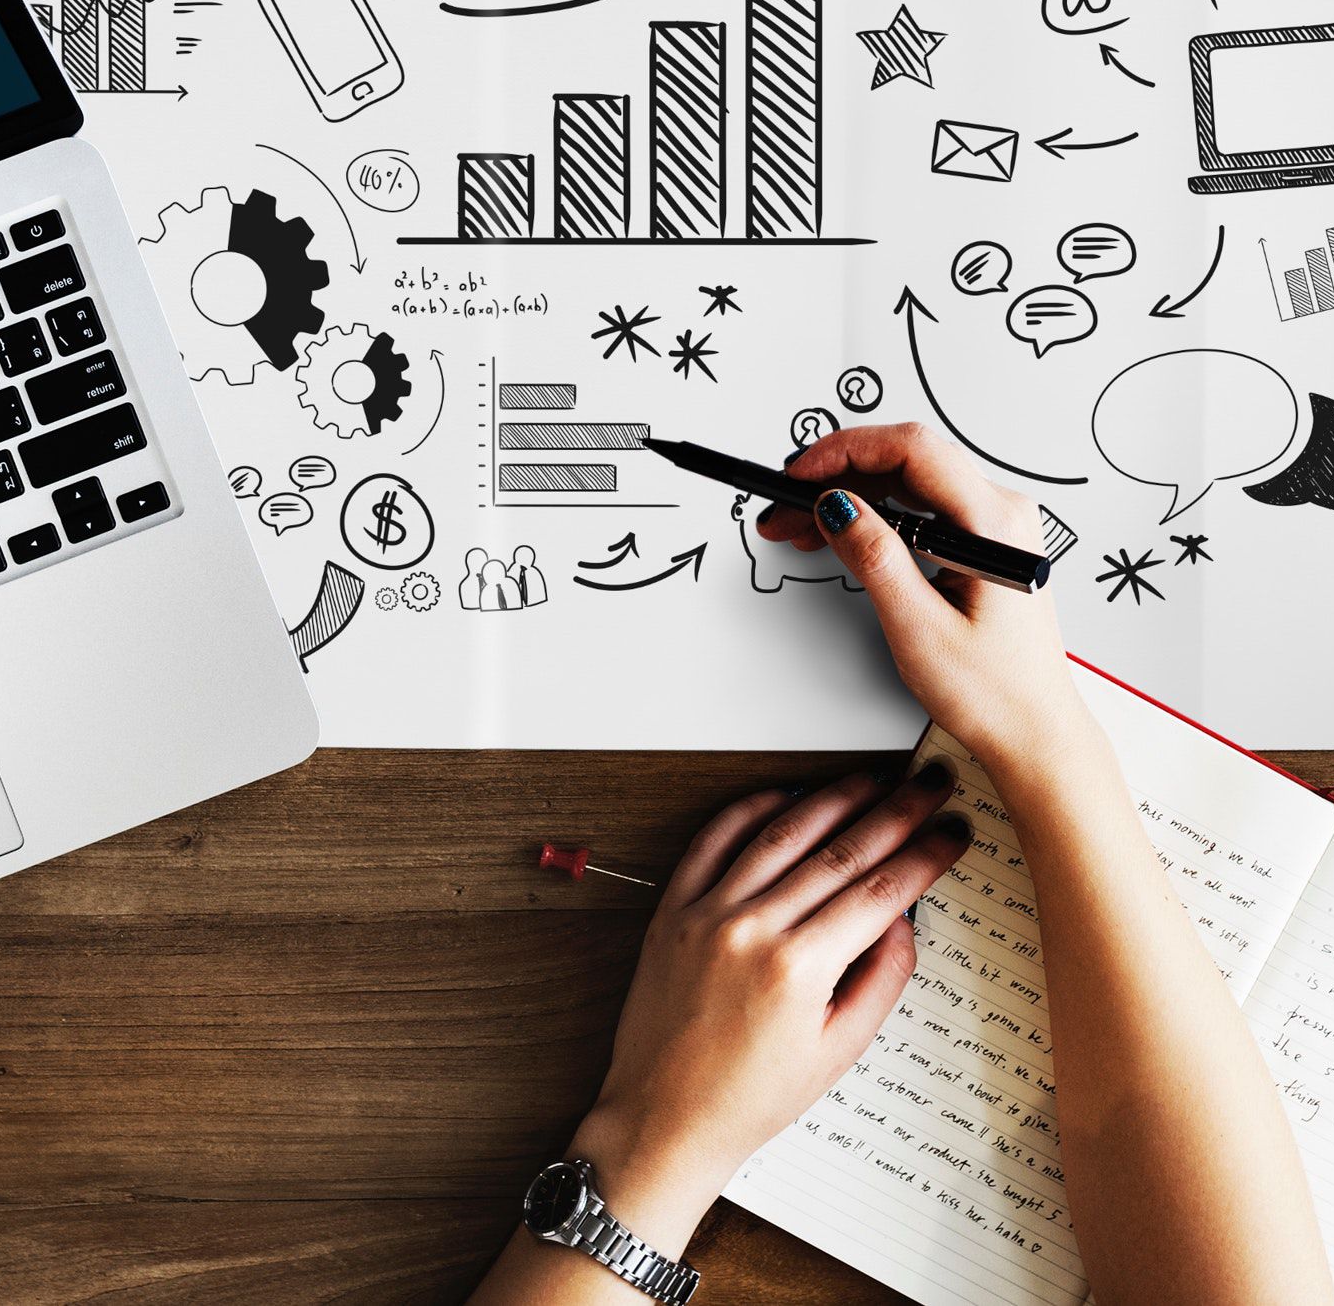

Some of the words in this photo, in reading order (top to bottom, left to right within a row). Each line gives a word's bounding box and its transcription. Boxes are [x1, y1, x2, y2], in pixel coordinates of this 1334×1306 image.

[360, 162, 407, 193] 40%
[44, 277, 73, 293] delete
[85, 361, 105, 373] enter
[86, 382, 115, 398] return
[113, 434, 134, 449] shift
[1138, 800, 1163, 821] this
[1170, 819, 1221, 855] morning.
[1250, 859, 1271, 878] had
[980, 882, 994, 895] to
[1204, 880, 1222, 892] all
[1229, 893, 1256, 908] went
[958, 910, 980, 927] but
[1011, 941, 1038, 958] still
[941, 943, 972, 969] little
[979, 963, 1000, 982] bit
[1009, 980, 1041, 1005] worry
[1306, 972, 1318, 990] is
[898, 1003, 913, 1018] be
[923, 1020, 949, 1037] more
[953, 1039, 1006, 1069] patient.
[981, 1011, 1020, 1034] gonna
[1272, 1032, 1301, 1062] the
[894, 1042, 909, 1052] I
[909, 1052, 930, 1068] was
[929, 1063, 963, 1083] just
[967, 1083, 1002, 1105] about
[1005, 1102, 1020, 1115] to
[1019, 1115, 1051, 1133] give
[876, 1076, 932, 1105] customer
[991, 1135, 1022, 1158] She's
[1026, 1157, 1035, 1167] a
[1041, 1165, 1064, 1182] nice
[853, 1103, 886, 1125] loved
[893, 1126, 914, 1141] our
[917, 1142, 971, 1173] product.
[1002, 1184, 1044, 1211] bought
[1044, 1209, 1062, 1224] 5
[875, 1158, 916, 1183] wanted
[921, 1180, 931, 1192] to
[965, 1205, 987, 1230] her,
[994, 1221, 1025, 1247] haha
